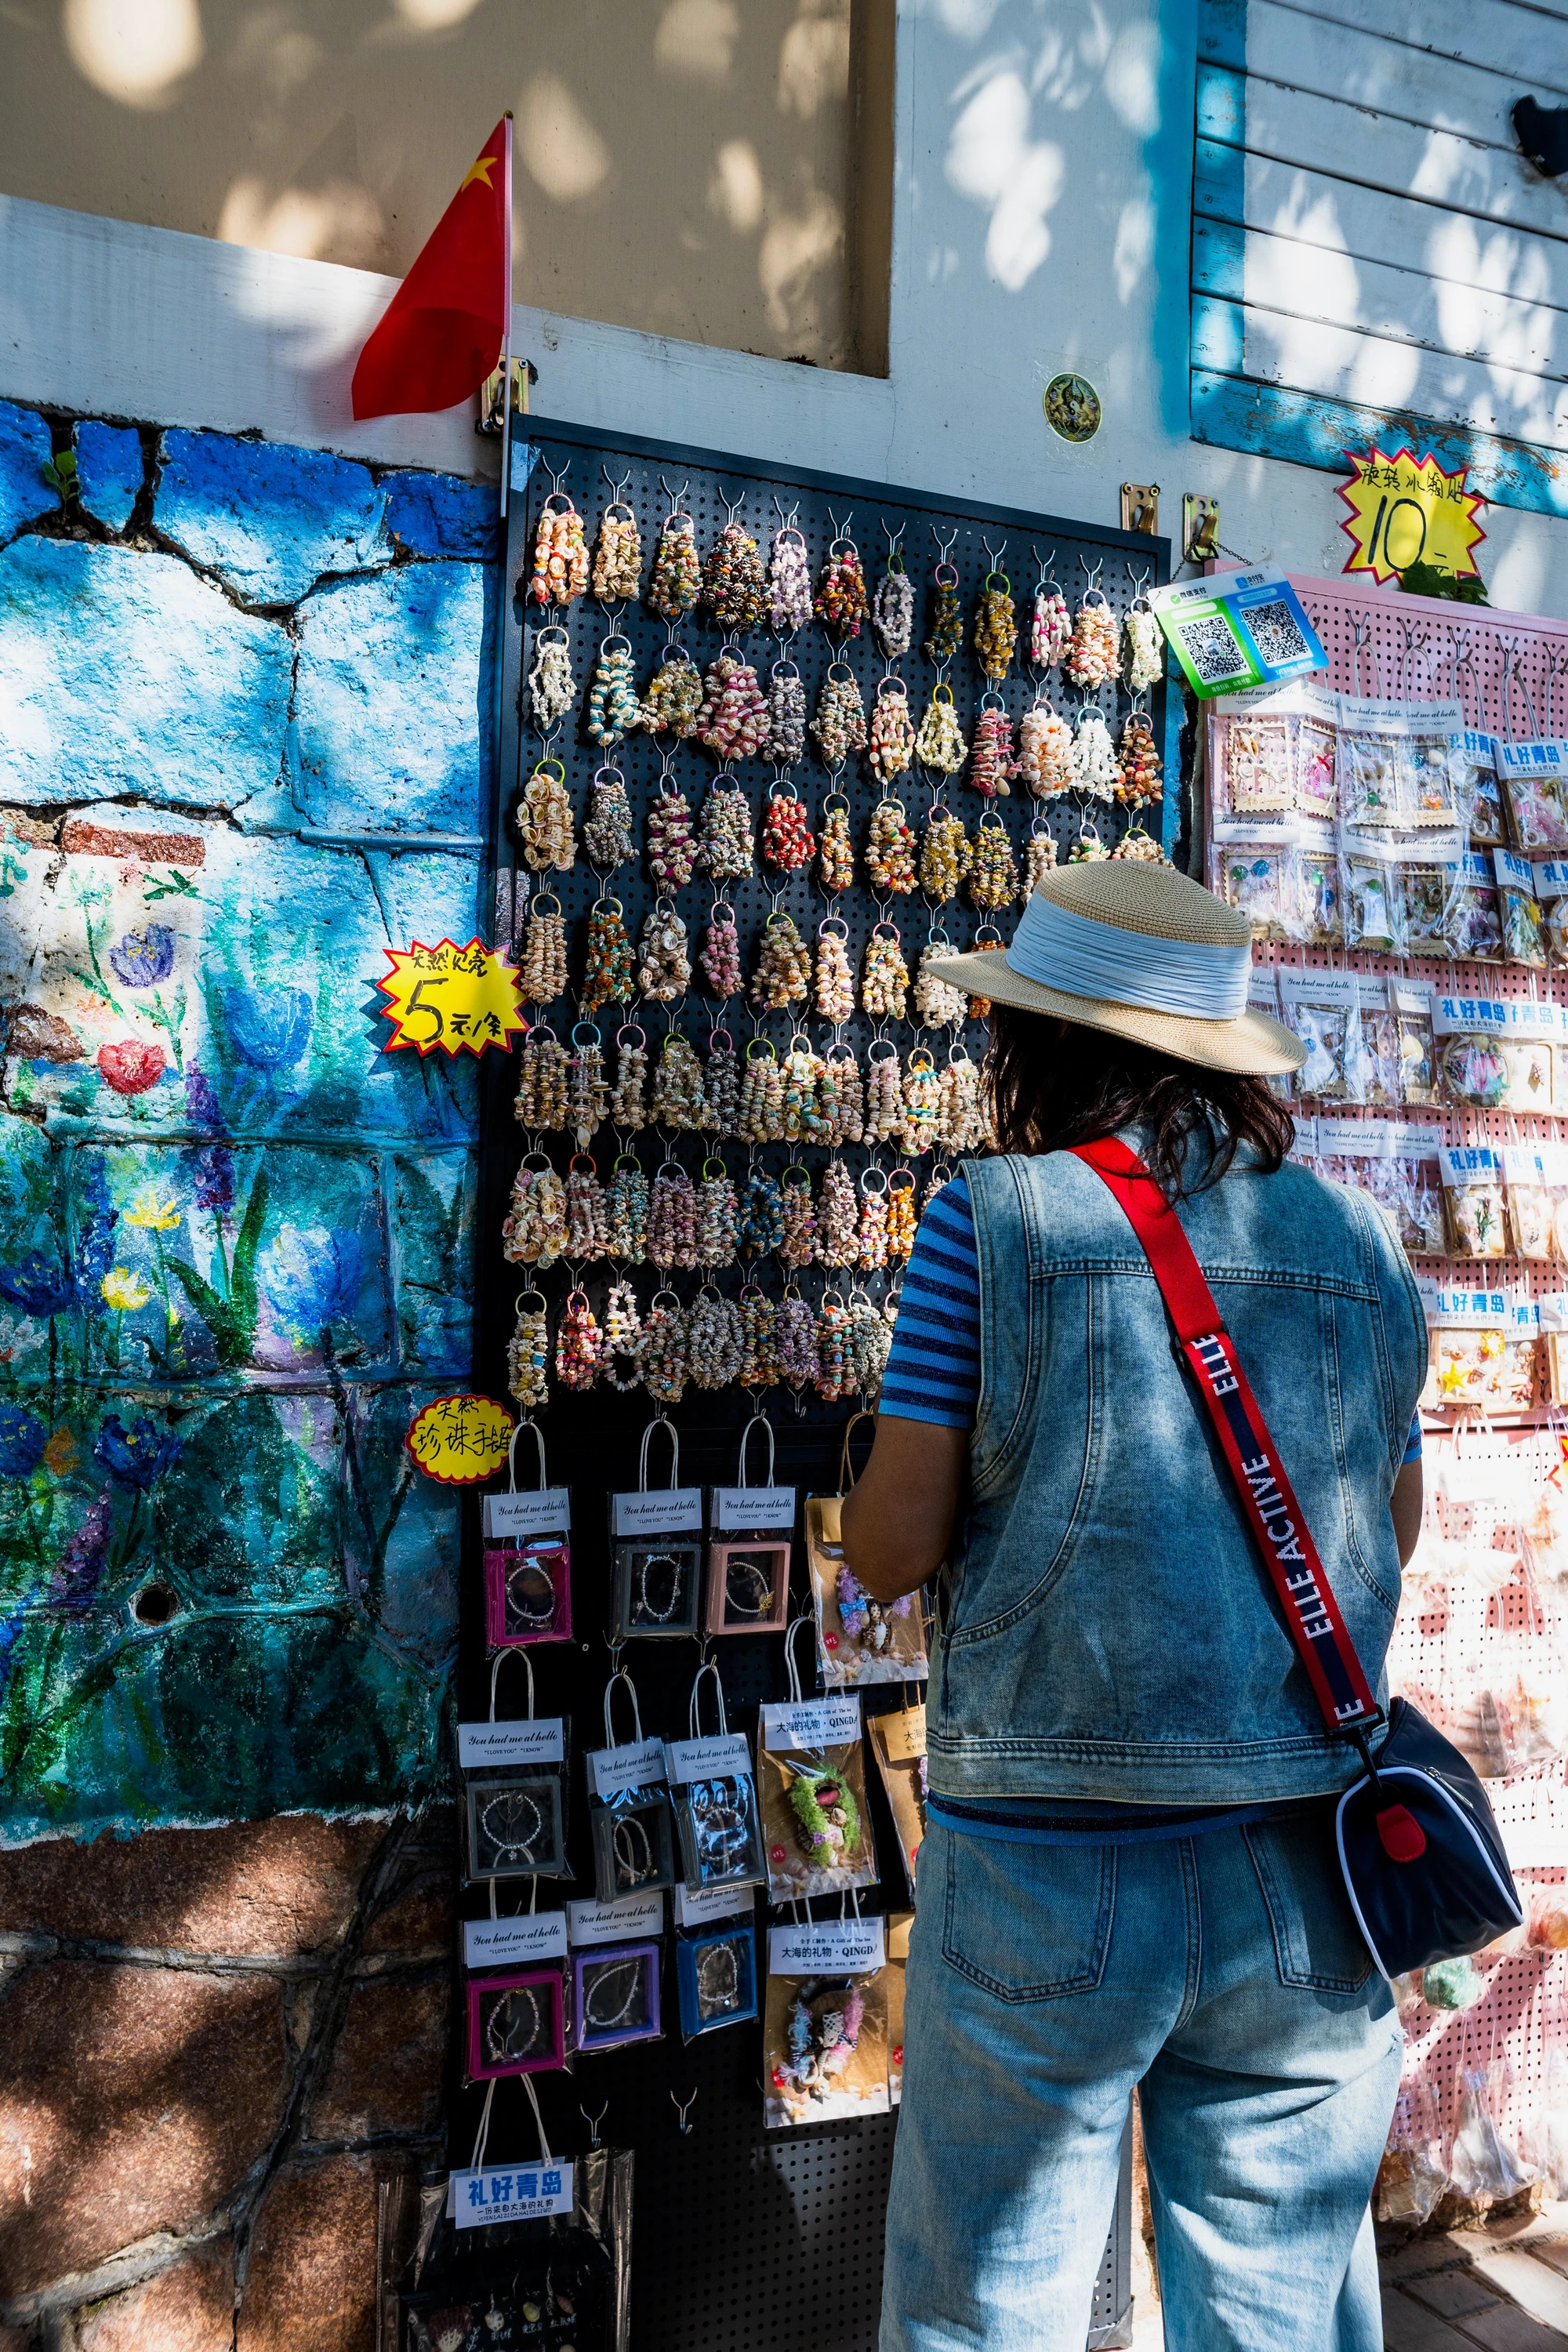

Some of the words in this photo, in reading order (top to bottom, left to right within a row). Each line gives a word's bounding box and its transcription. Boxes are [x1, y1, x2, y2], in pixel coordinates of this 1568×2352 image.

[1179, 586, 1207, 598] 微信支付
[1503, 745, 1560, 765] 礼好青岛
[412, 948, 488, 978] 天然贝壳
[1287, 978, 1301, 987] You
[1442, 1000, 1505, 1023] 礼好青岛
[1323, 1128, 1338, 1138] You
[1338, 1130, 1350, 1138] had
[1361, 1131, 1370, 1139] at
[1370, 1131, 1385, 1141] hello
[1190, 1334, 1239, 1396] ELLE
[437, 1397, 479, 1421] 天然
[498, 1505, 512, 1515] You
[514, 1504, 529, 1514] had
[542, 1502, 550, 1511] at
[550, 1500, 566, 1510] hello
[623, 1505, 639, 1515] You
[640, 1504, 656, 1513] had
[669, 1501, 678, 1511] at
[678, 1500, 696, 1510] hello
[724, 1500, 739, 1509] You
[739, 1500, 755, 1508] had
[766, 1500, 775, 1508] at
[775, 1498, 791, 1508] hello
[1241, 1454, 1306, 1560] ACTIVE
[1285, 1569, 1334, 1639] ELLE
[776, 1719, 820, 1733] 大海的礼物
[468, 1735, 486, 1745] You
[488, 1734, 508, 1744] had
[524, 1733, 535, 1742] at
[535, 1730, 557, 1741] hello
[599, 1763, 612, 1773] You
[614, 1759, 627, 1770] had
[638, 1755, 646, 1764] at
[646, 1750, 661, 1762] hello
[680, 1752, 695, 1762] You
[697, 1750, 711, 1759] had
[723, 1746, 731, 1755] at
[731, 1744, 746, 1755] hello
[578, 1914, 594, 1924] You
[596, 1911, 614, 1922] had
[627, 1907, 637, 1916] at
[637, 1904, 658, 1915] hello
[473, 1935, 491, 1945] You
[493, 1933, 512, 1944] had
[528, 1929, 538, 1938] at
[539, 1925, 561, 1937] hello
[782, 1947, 832, 1958] 大海的礼物
[468, 2171, 562, 2207] 礼好青岛
[477, 2199, 554, 2215] 一份来自大海的礼物
